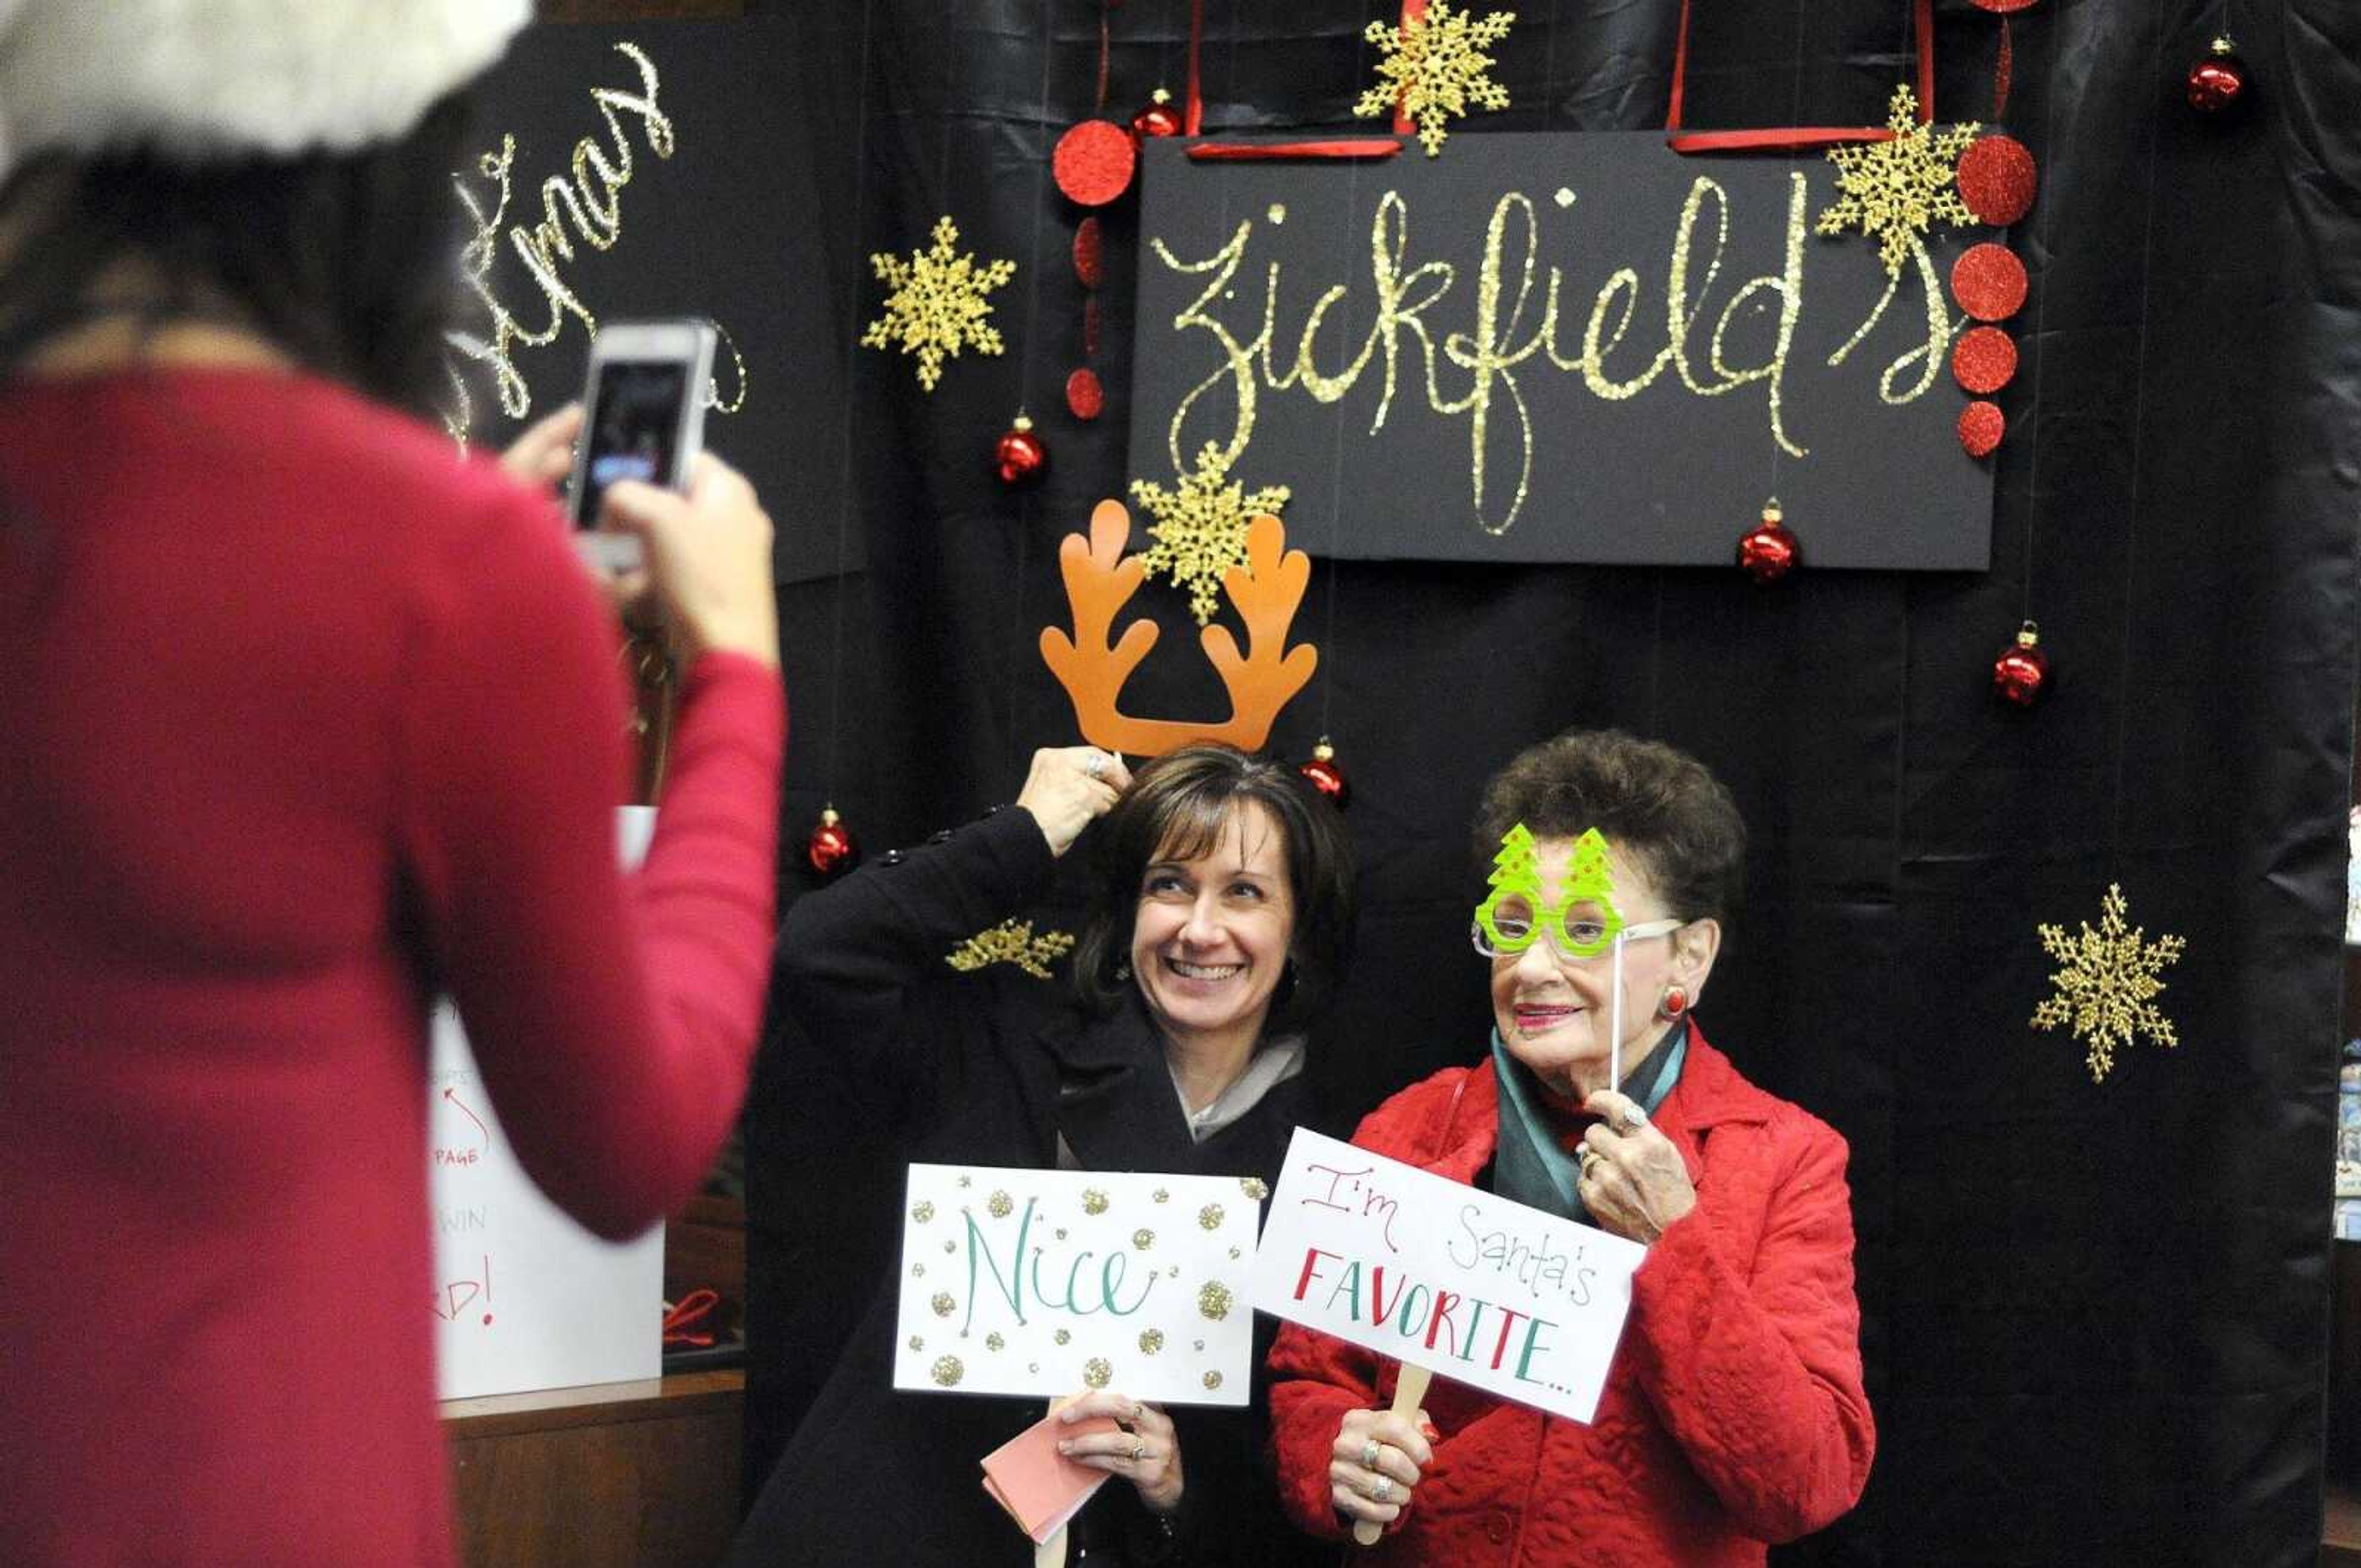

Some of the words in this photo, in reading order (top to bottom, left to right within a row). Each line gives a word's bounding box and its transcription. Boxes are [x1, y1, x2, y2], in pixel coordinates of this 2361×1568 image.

[1151, 171, 1970, 535] Zickfields
[959, 1195, 1158, 1338] Nice
[1302, 1164, 1399, 1253] I'm
[1447, 1204, 1597, 1307] Santa's
